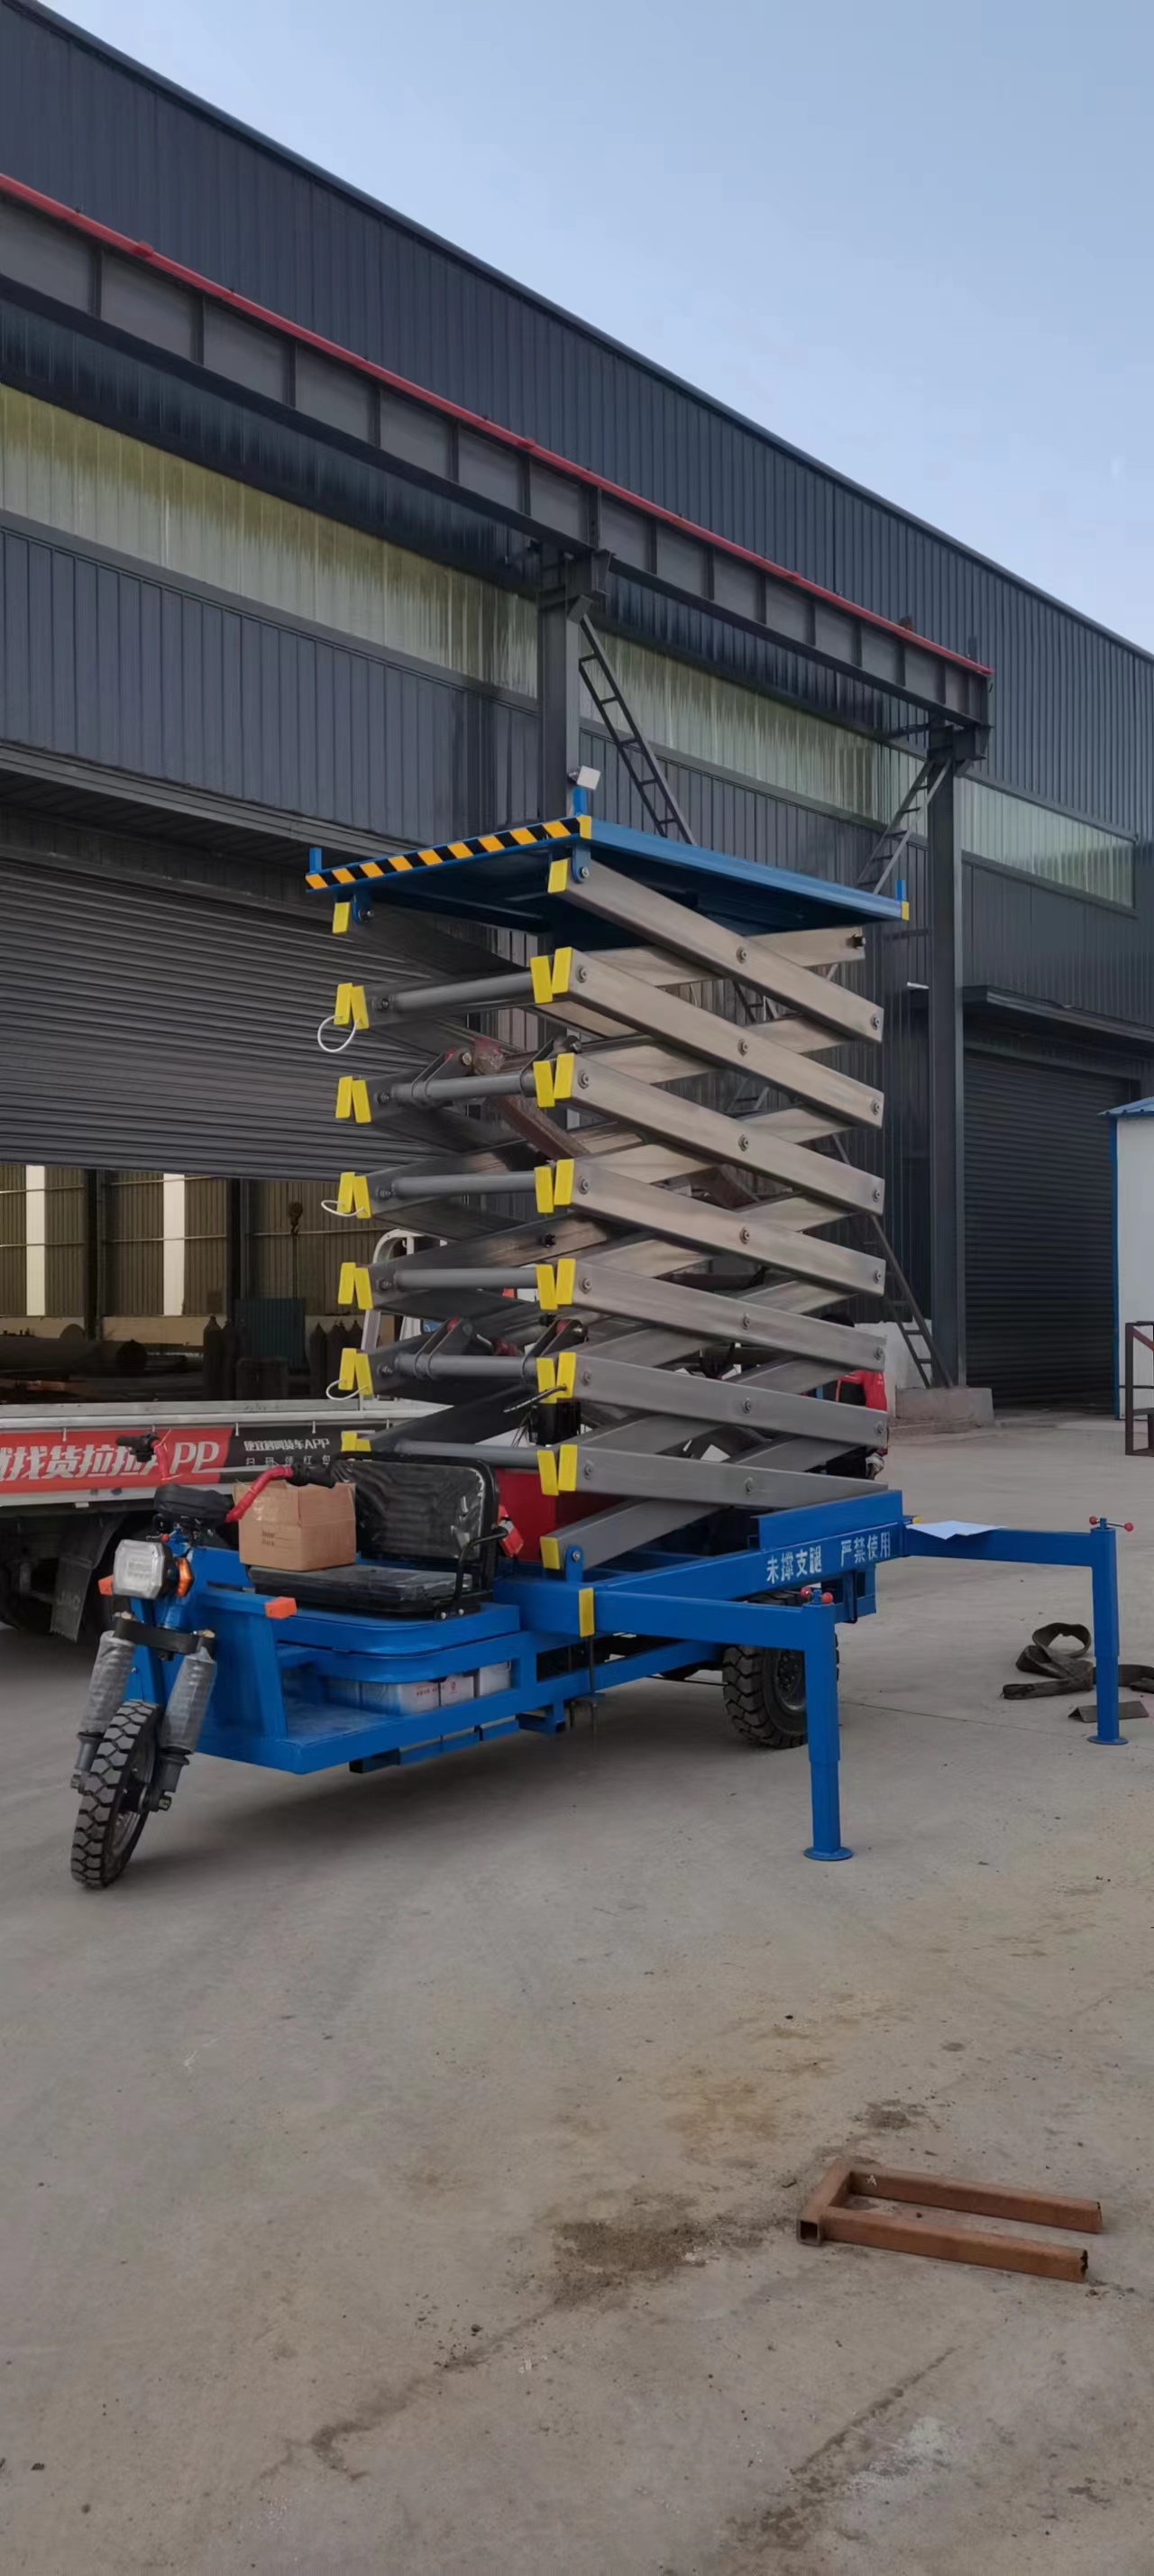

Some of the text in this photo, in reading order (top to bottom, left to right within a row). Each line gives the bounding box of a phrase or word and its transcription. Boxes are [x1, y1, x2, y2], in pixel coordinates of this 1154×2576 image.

[765, 1531, 891, 1584] 未撑支腿 严禁使用
